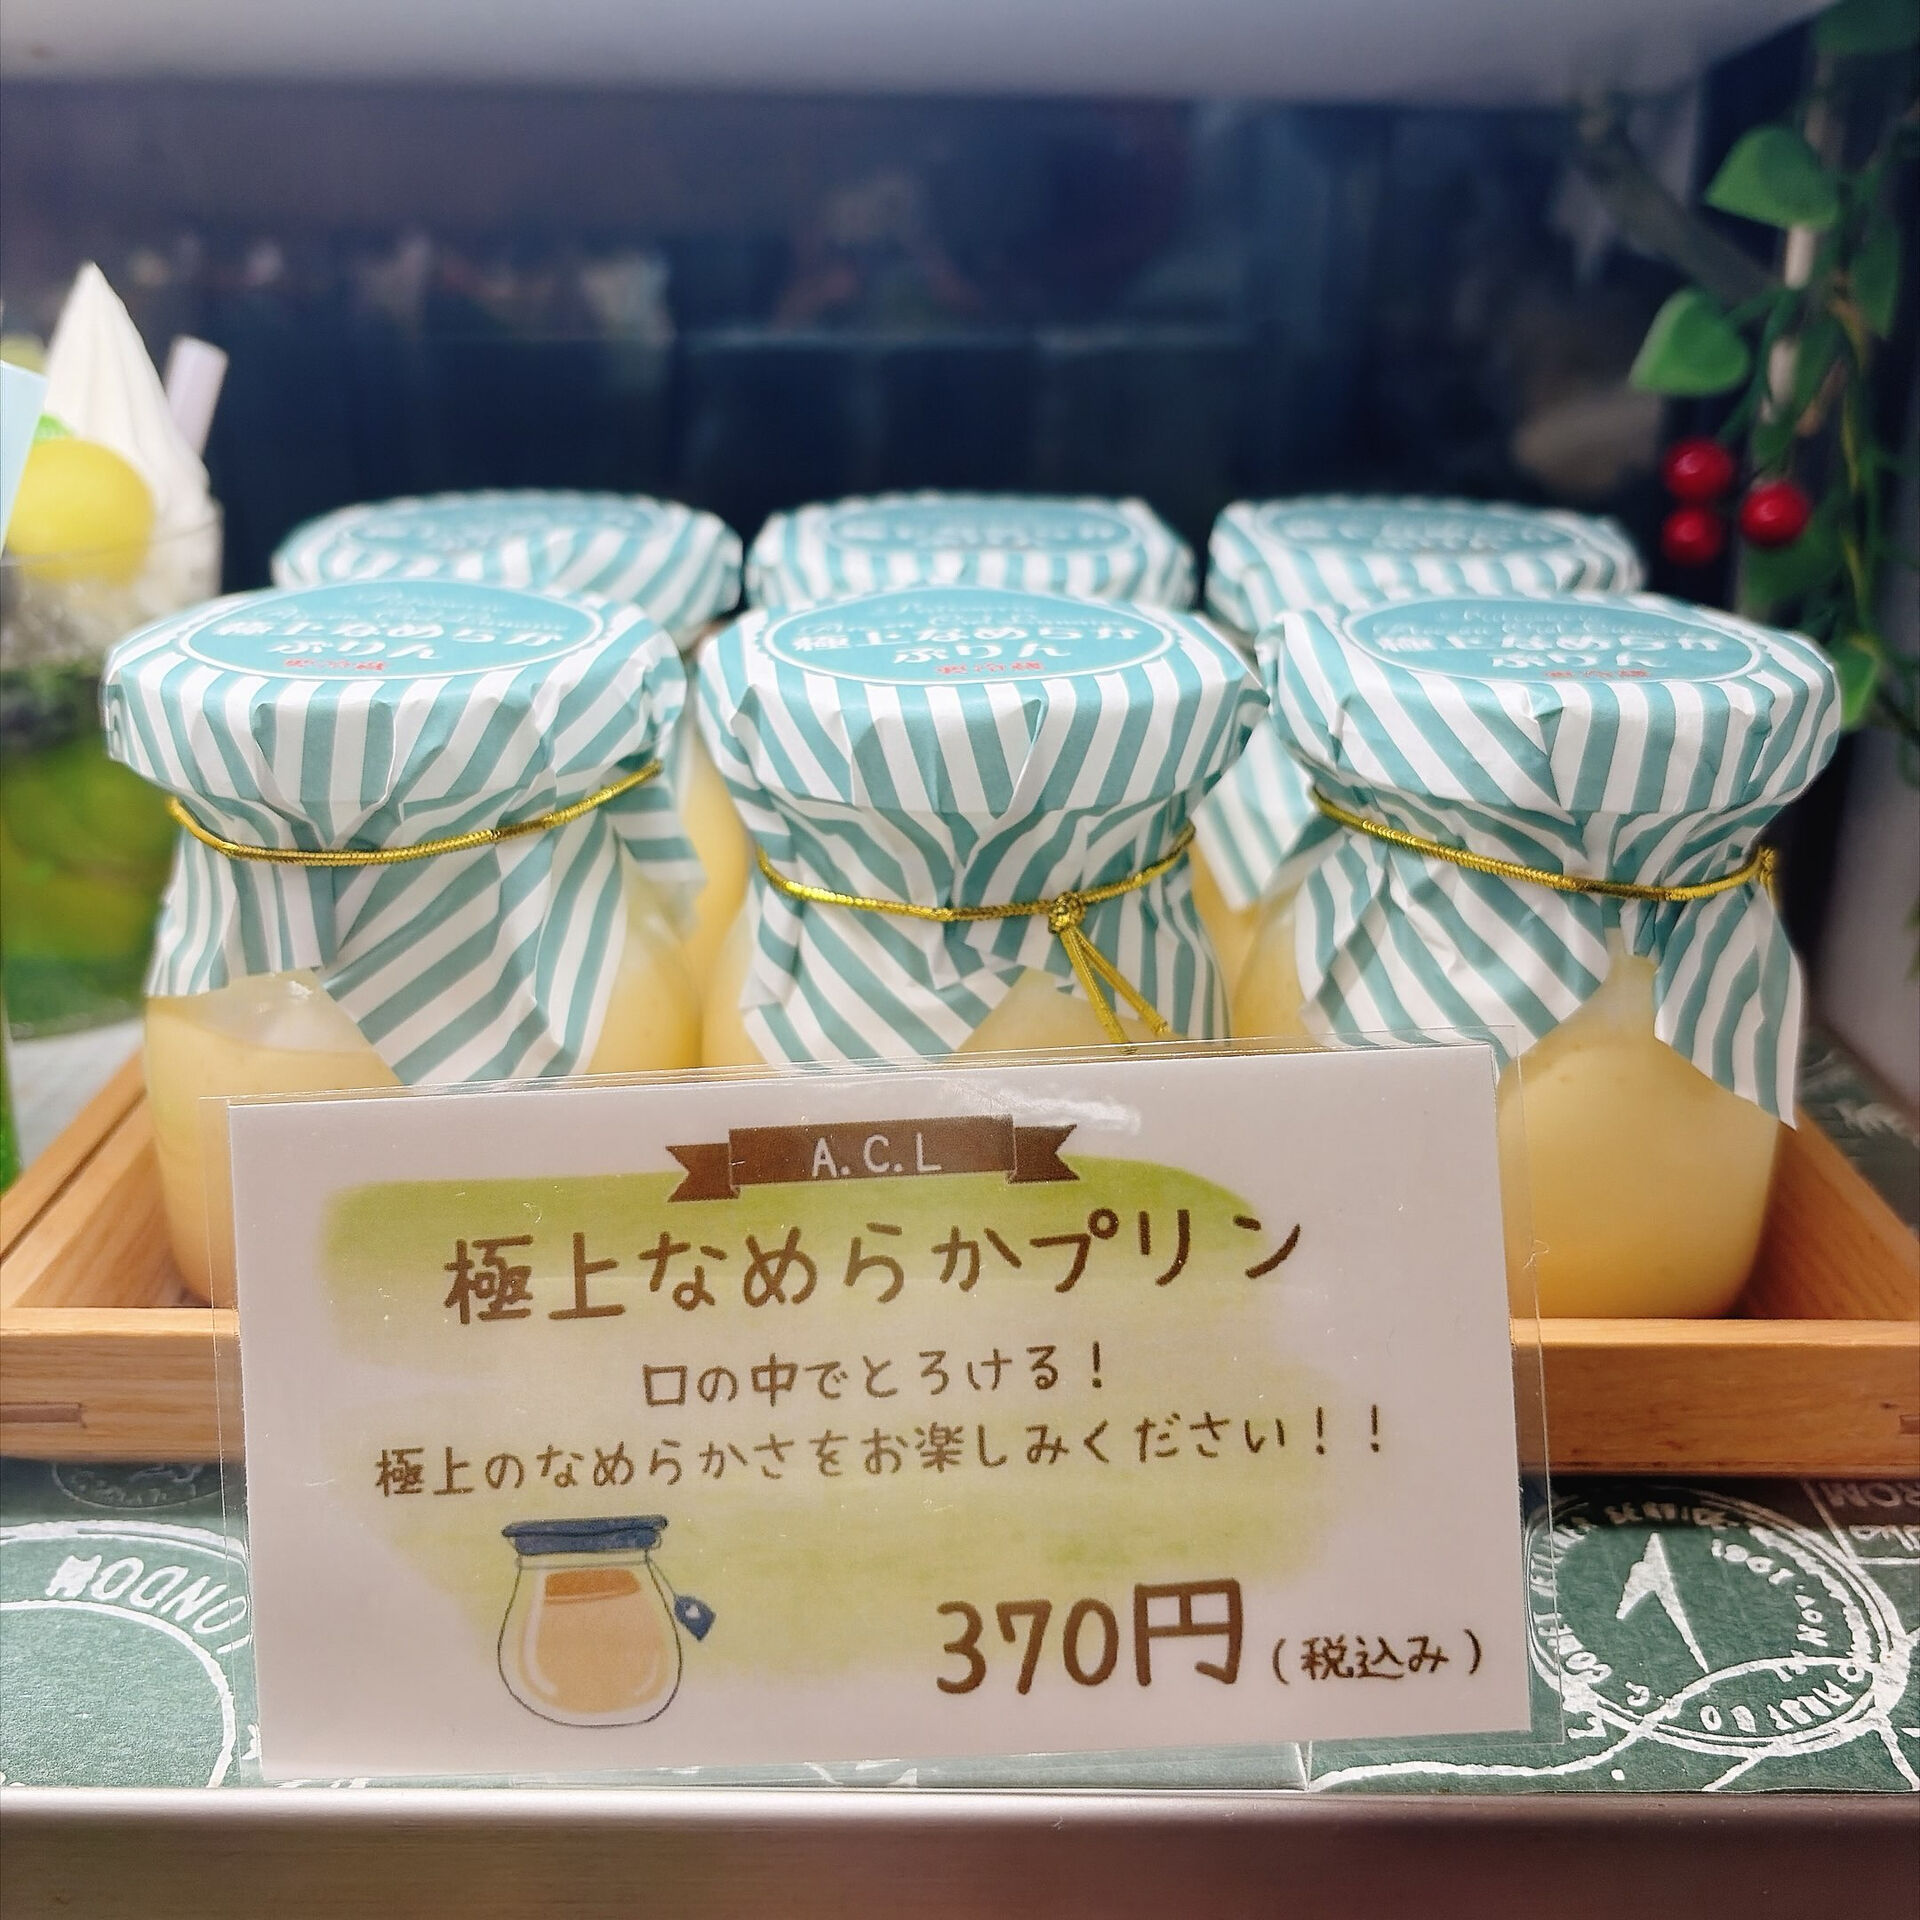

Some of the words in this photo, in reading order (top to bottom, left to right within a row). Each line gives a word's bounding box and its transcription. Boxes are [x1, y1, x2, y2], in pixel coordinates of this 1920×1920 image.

[813, 1133, 942, 1177] A.C.L
[444, 1206, 1302, 1326] 極上なめらかプリン
[643, 1342, 1105, 1408] 口の中でとろける！
[936, 1577, 1244, 1696] 370円
[1272, 1628, 1482, 1685] （税込み）
